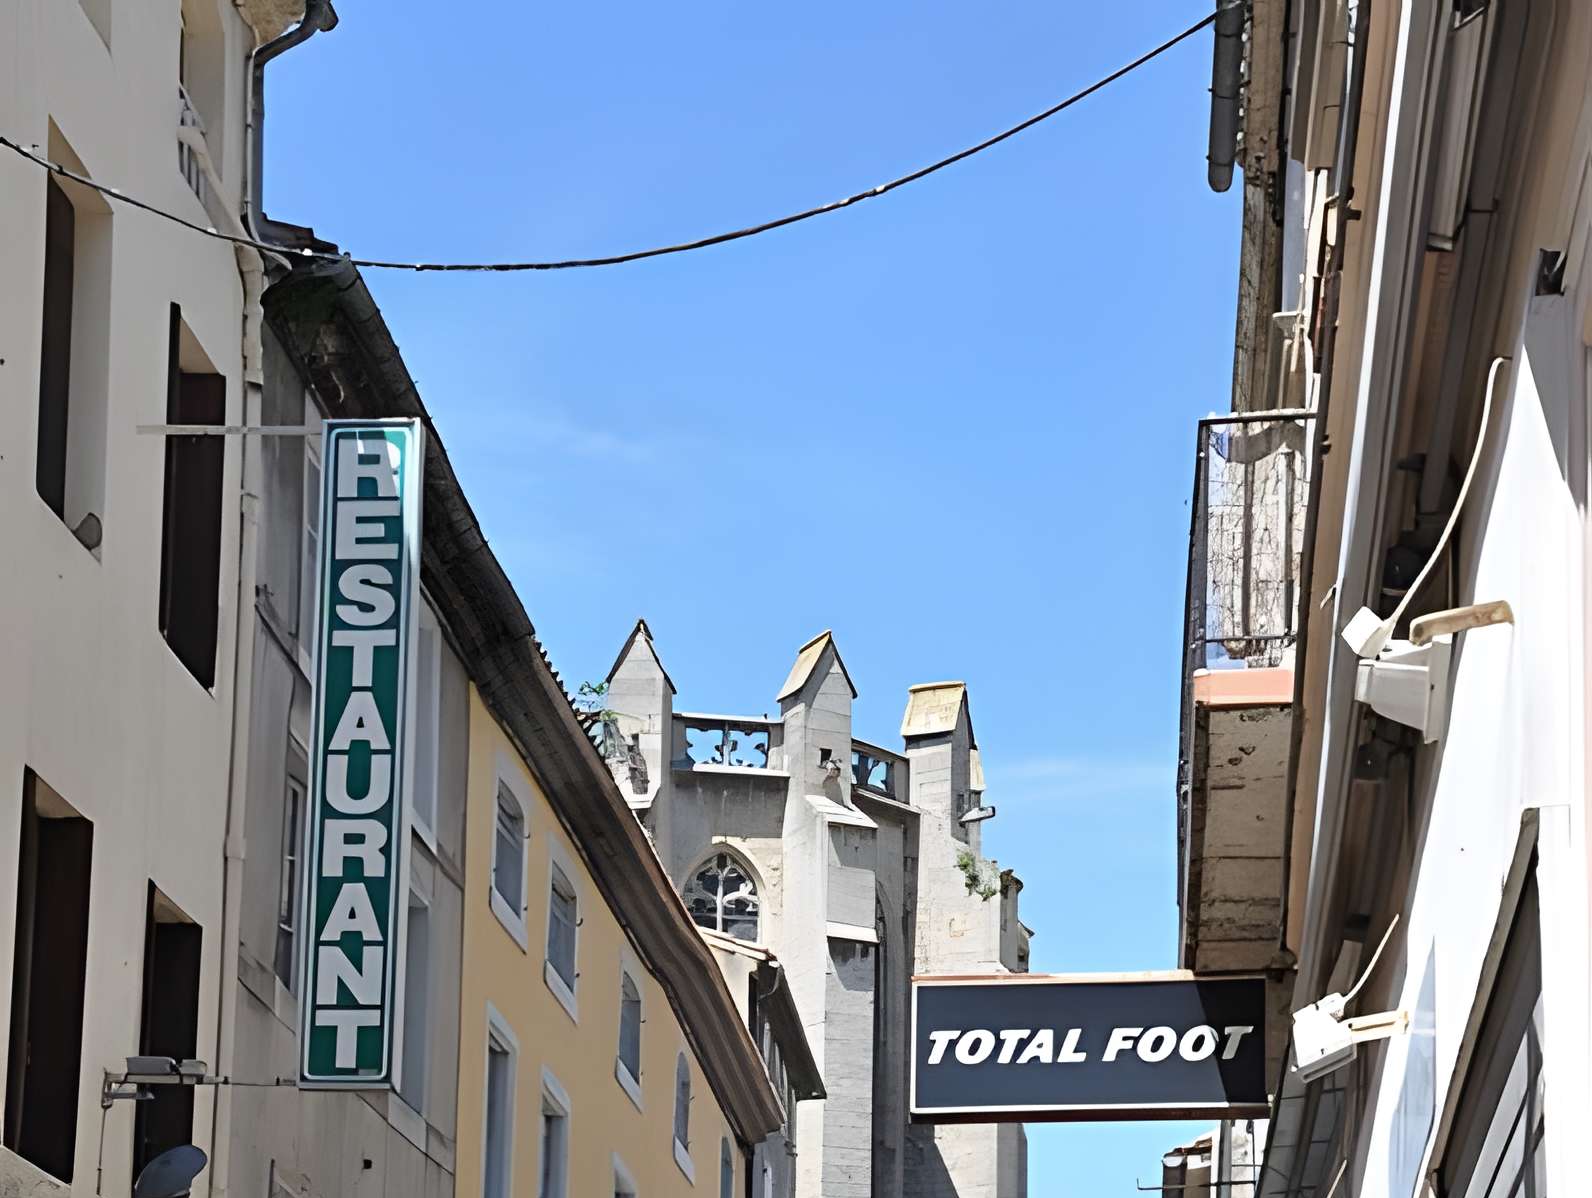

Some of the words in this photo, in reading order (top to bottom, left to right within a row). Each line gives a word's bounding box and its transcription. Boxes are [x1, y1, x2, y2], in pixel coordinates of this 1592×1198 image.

[315, 437, 401, 1069] RESTAURANT
[927, 1028, 1087, 1065] TOTAL
[1101, 1024, 1254, 1063] FOOT
